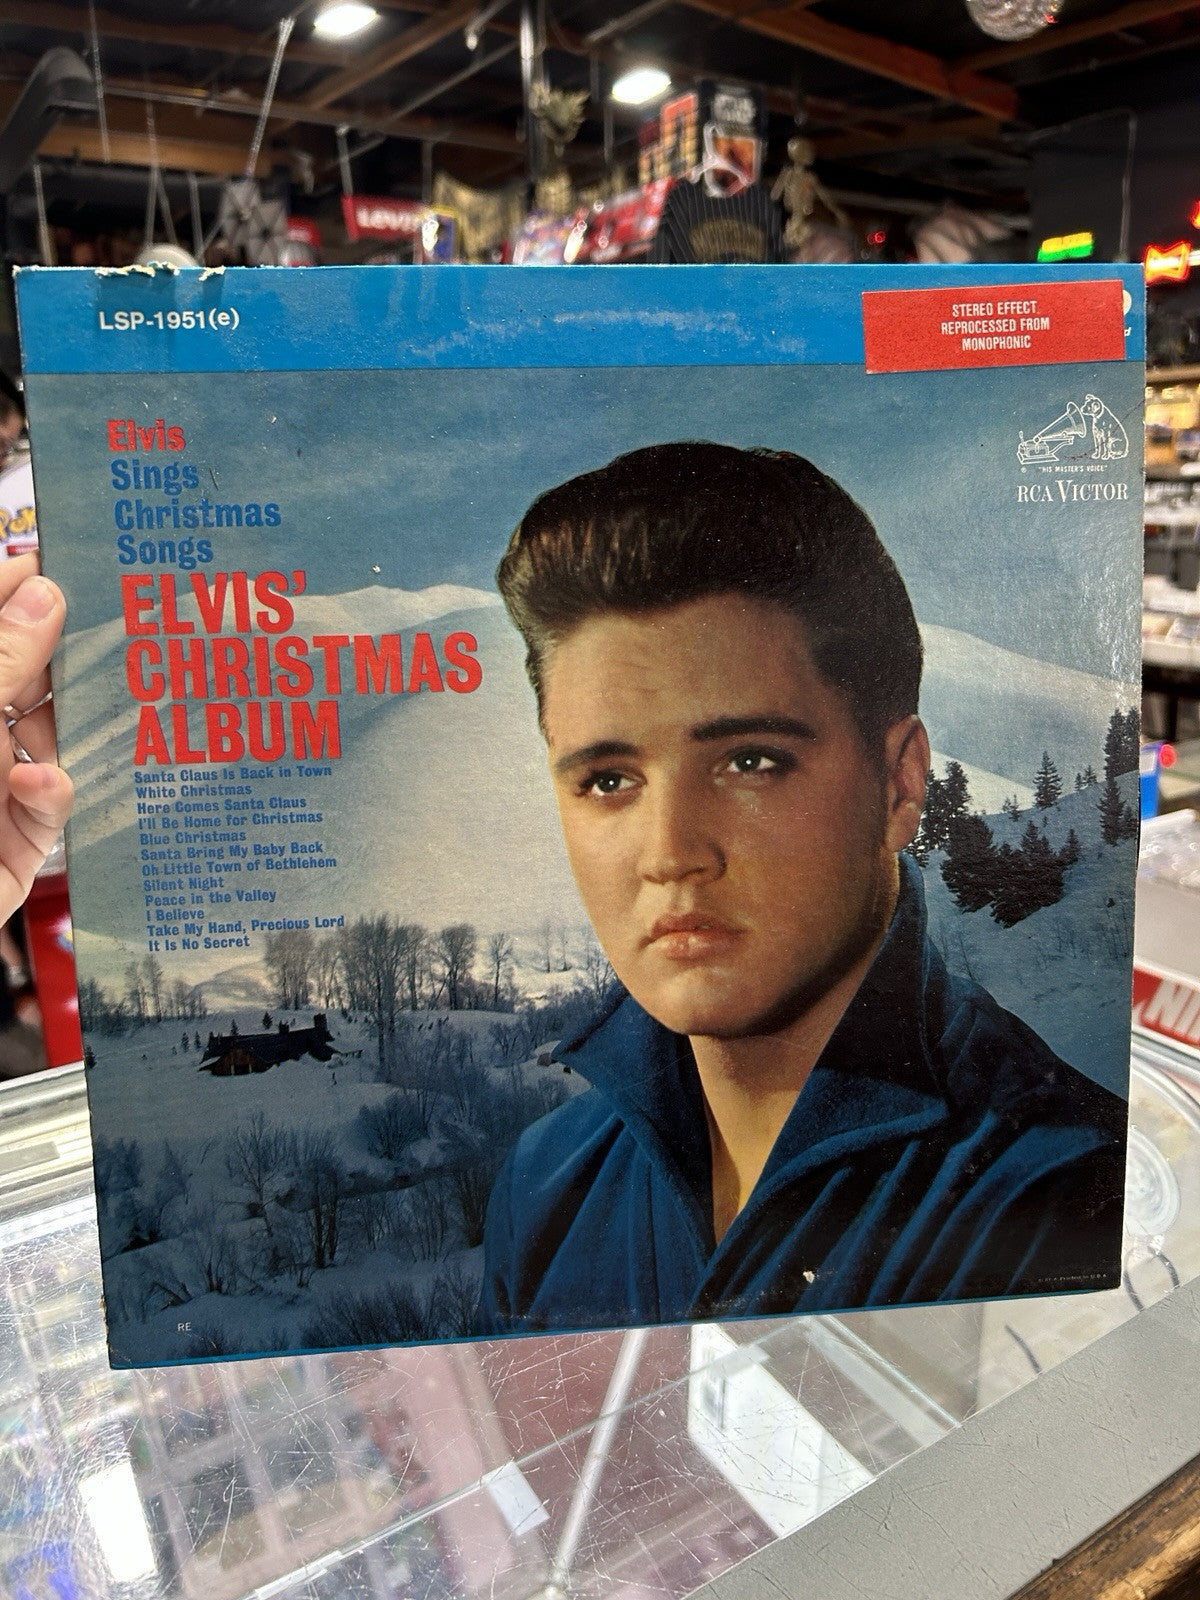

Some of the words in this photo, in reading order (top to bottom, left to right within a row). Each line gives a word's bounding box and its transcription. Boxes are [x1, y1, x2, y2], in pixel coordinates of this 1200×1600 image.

[952, 303, 993, 318] STEREO
[997, 301, 1037, 315] EFFECT
[99, 307, 240, 331] LSP-1951(e)
[941, 320, 1016, 335] REPROCESSED
[1020, 317, 1050, 331] FROM
[962, 335, 1031, 351] MONOPHONIC
[107, 419, 186, 452] Elvis
[110, 458, 200, 496] Sings
[1017, 484, 1054, 503] RCA
[1055, 479, 1129, 502] VICTOR
[114, 499, 282, 531] Christmas
[116, 534, 215, 571] Songs
[120, 570, 307, 637] ELVIS'
[125, 631, 483, 702] CHRISTMAS
[133, 699, 342, 766] ALBUM
[134, 771, 175, 784] Santa
[180, 770, 218, 782] Claus
[223, 769, 235, 780] Is
[241, 767, 273, 779] Back
[279, 766, 291, 777] in
[296, 766, 332, 777] Town
[136, 786, 176, 799] White
[180, 785, 252, 797] Christmas
[137, 802, 170, 814] Here
[175, 801, 219, 813] Comes
[224, 799, 264, 811] Santa
[269, 798, 306, 808] Claus
[138, 818, 156, 829] I'll
[162, 817, 179, 829] Be
[184, 815, 221, 828] Home
[225, 815, 248, 826] for
[252, 812, 323, 824] Christmas
[139, 833, 170, 845] Blue
[175, 831, 246, 844] Christmas
[141, 849, 182, 861] Santa
[187, 847, 224, 860] Bring
[229, 845, 248, 858] My
[254, 843, 285, 857] Baby
[291, 842, 323, 853] Back
[142, 865, 159, 877] Oh
[164, 863, 201, 875] Little
[206, 861, 241, 873] Town
[247, 859, 260, 871] of
[266, 857, 337, 870] Bethlehem
[143, 879, 183, 892] Silent
[188, 877, 224, 891] Night
[145, 895, 186, 907] Peace
[191, 893, 203, 904] in
[209, 891, 231, 904] the
[235, 890, 276, 903] Valley
[146, 910, 151, 921] I
[156, 908, 204, 921] Believe
[147, 924, 179, 937] Take
[184, 923, 203, 936] My
[209, 921, 246, 934] Hand,
[251, 918, 309, 931] Precious
[315, 916, 345, 927] Lord
[149, 940, 160, 951] It
[165, 939, 176, 951] Is
[182, 938, 199, 950] No
[204, 936, 250, 948] Secret
[177, 1321, 192, 1332] RE
